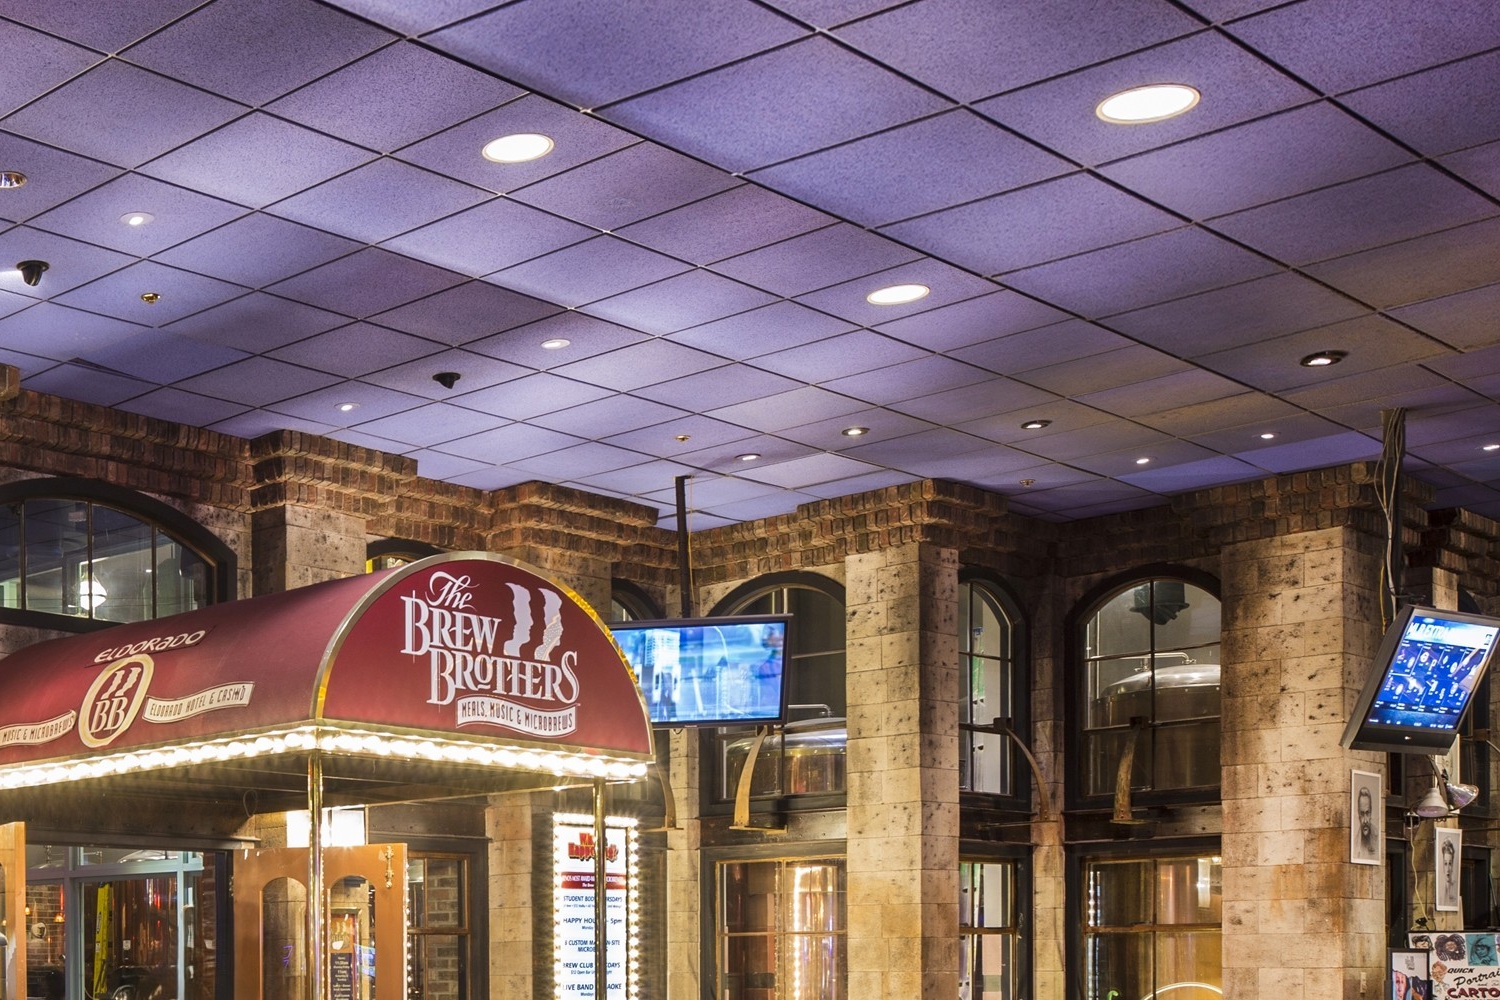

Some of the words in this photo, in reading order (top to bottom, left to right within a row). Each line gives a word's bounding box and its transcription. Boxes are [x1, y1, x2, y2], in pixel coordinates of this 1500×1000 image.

[425, 571, 479, 612] The
[401, 590, 501, 663] BREW
[427, 648, 580, 712] BROTHERS
[150, 703, 183, 717] ELDORADO
[186, 695, 206, 712] HOTEL
[209, 692, 215, 704] &
[490, 702, 513, 722] MUSIC
[517, 709, 522, 724] &
[525, 712, 573, 731] MICROBREWS
[2, 729, 21, 741] MUSIC
[29, 717, 73, 740] MICROBREWS
